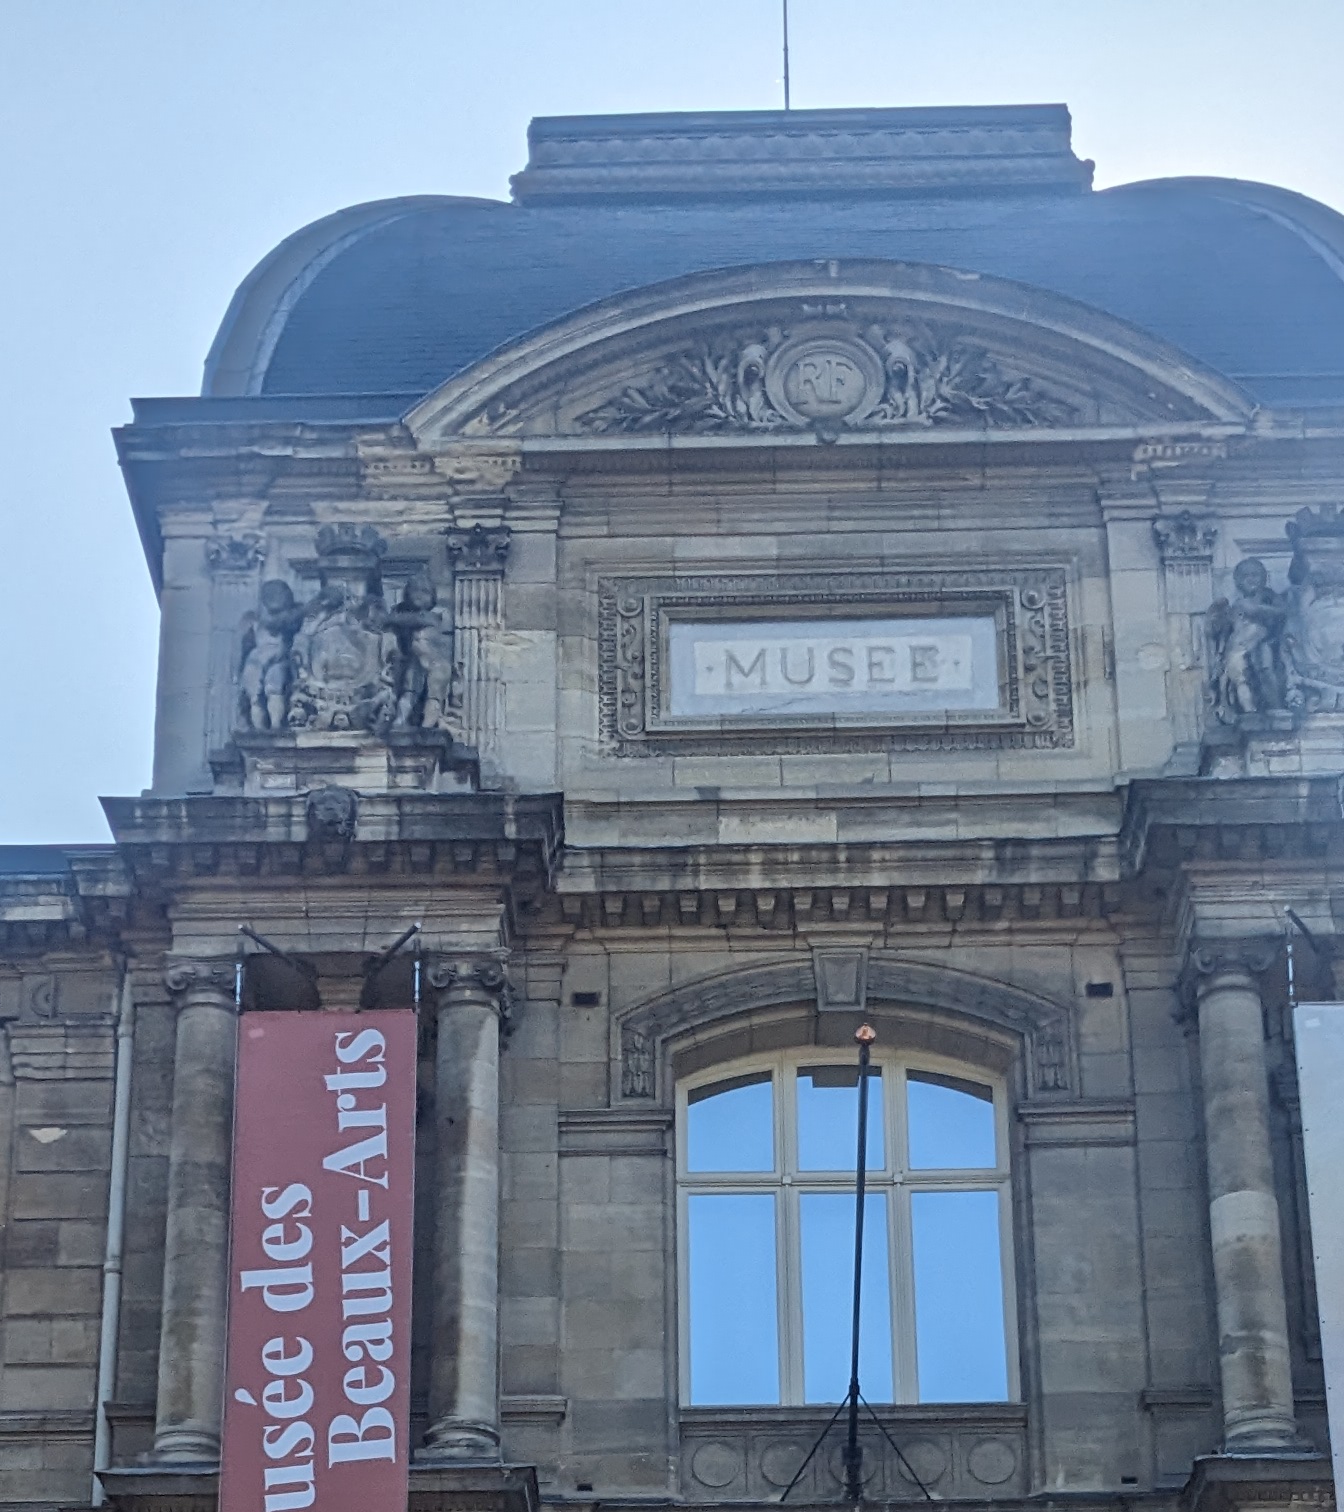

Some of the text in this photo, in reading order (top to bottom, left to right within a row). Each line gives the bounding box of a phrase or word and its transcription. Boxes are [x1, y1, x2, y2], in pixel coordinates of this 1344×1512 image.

[724, 644, 941, 688] MUSEE
[240, 1182, 314, 1313] des
[322, 1027, 398, 1469] Beaux-Arts
